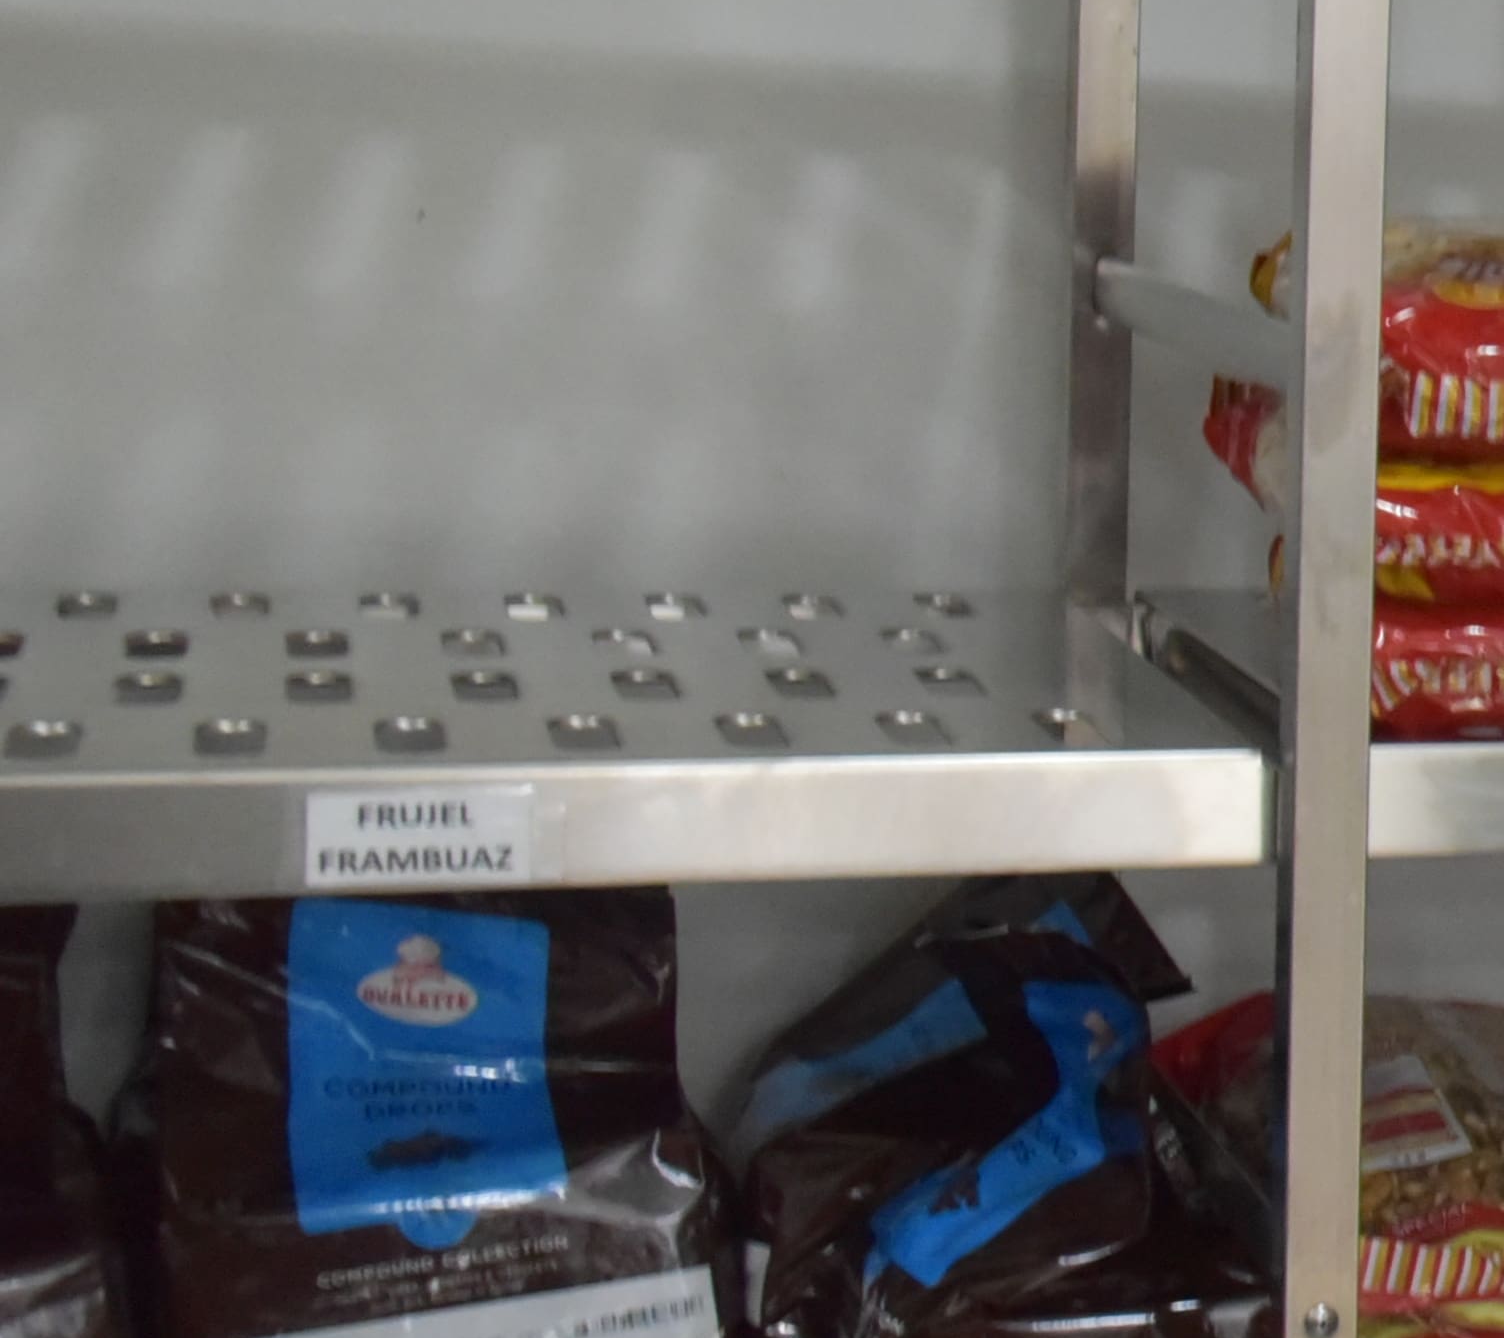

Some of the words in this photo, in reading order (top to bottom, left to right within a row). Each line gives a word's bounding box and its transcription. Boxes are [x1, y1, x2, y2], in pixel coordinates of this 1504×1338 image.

[357, 802, 473, 829] FRUJEL
[318, 845, 513, 874] FRAMBUAZ
[323, 1077, 512, 1101] COMPOUND
[363, 1101, 478, 1120] DROPS
[317, 1258, 436, 1290] COMPOUND
[443, 1236, 570, 1271] COLLECTION
